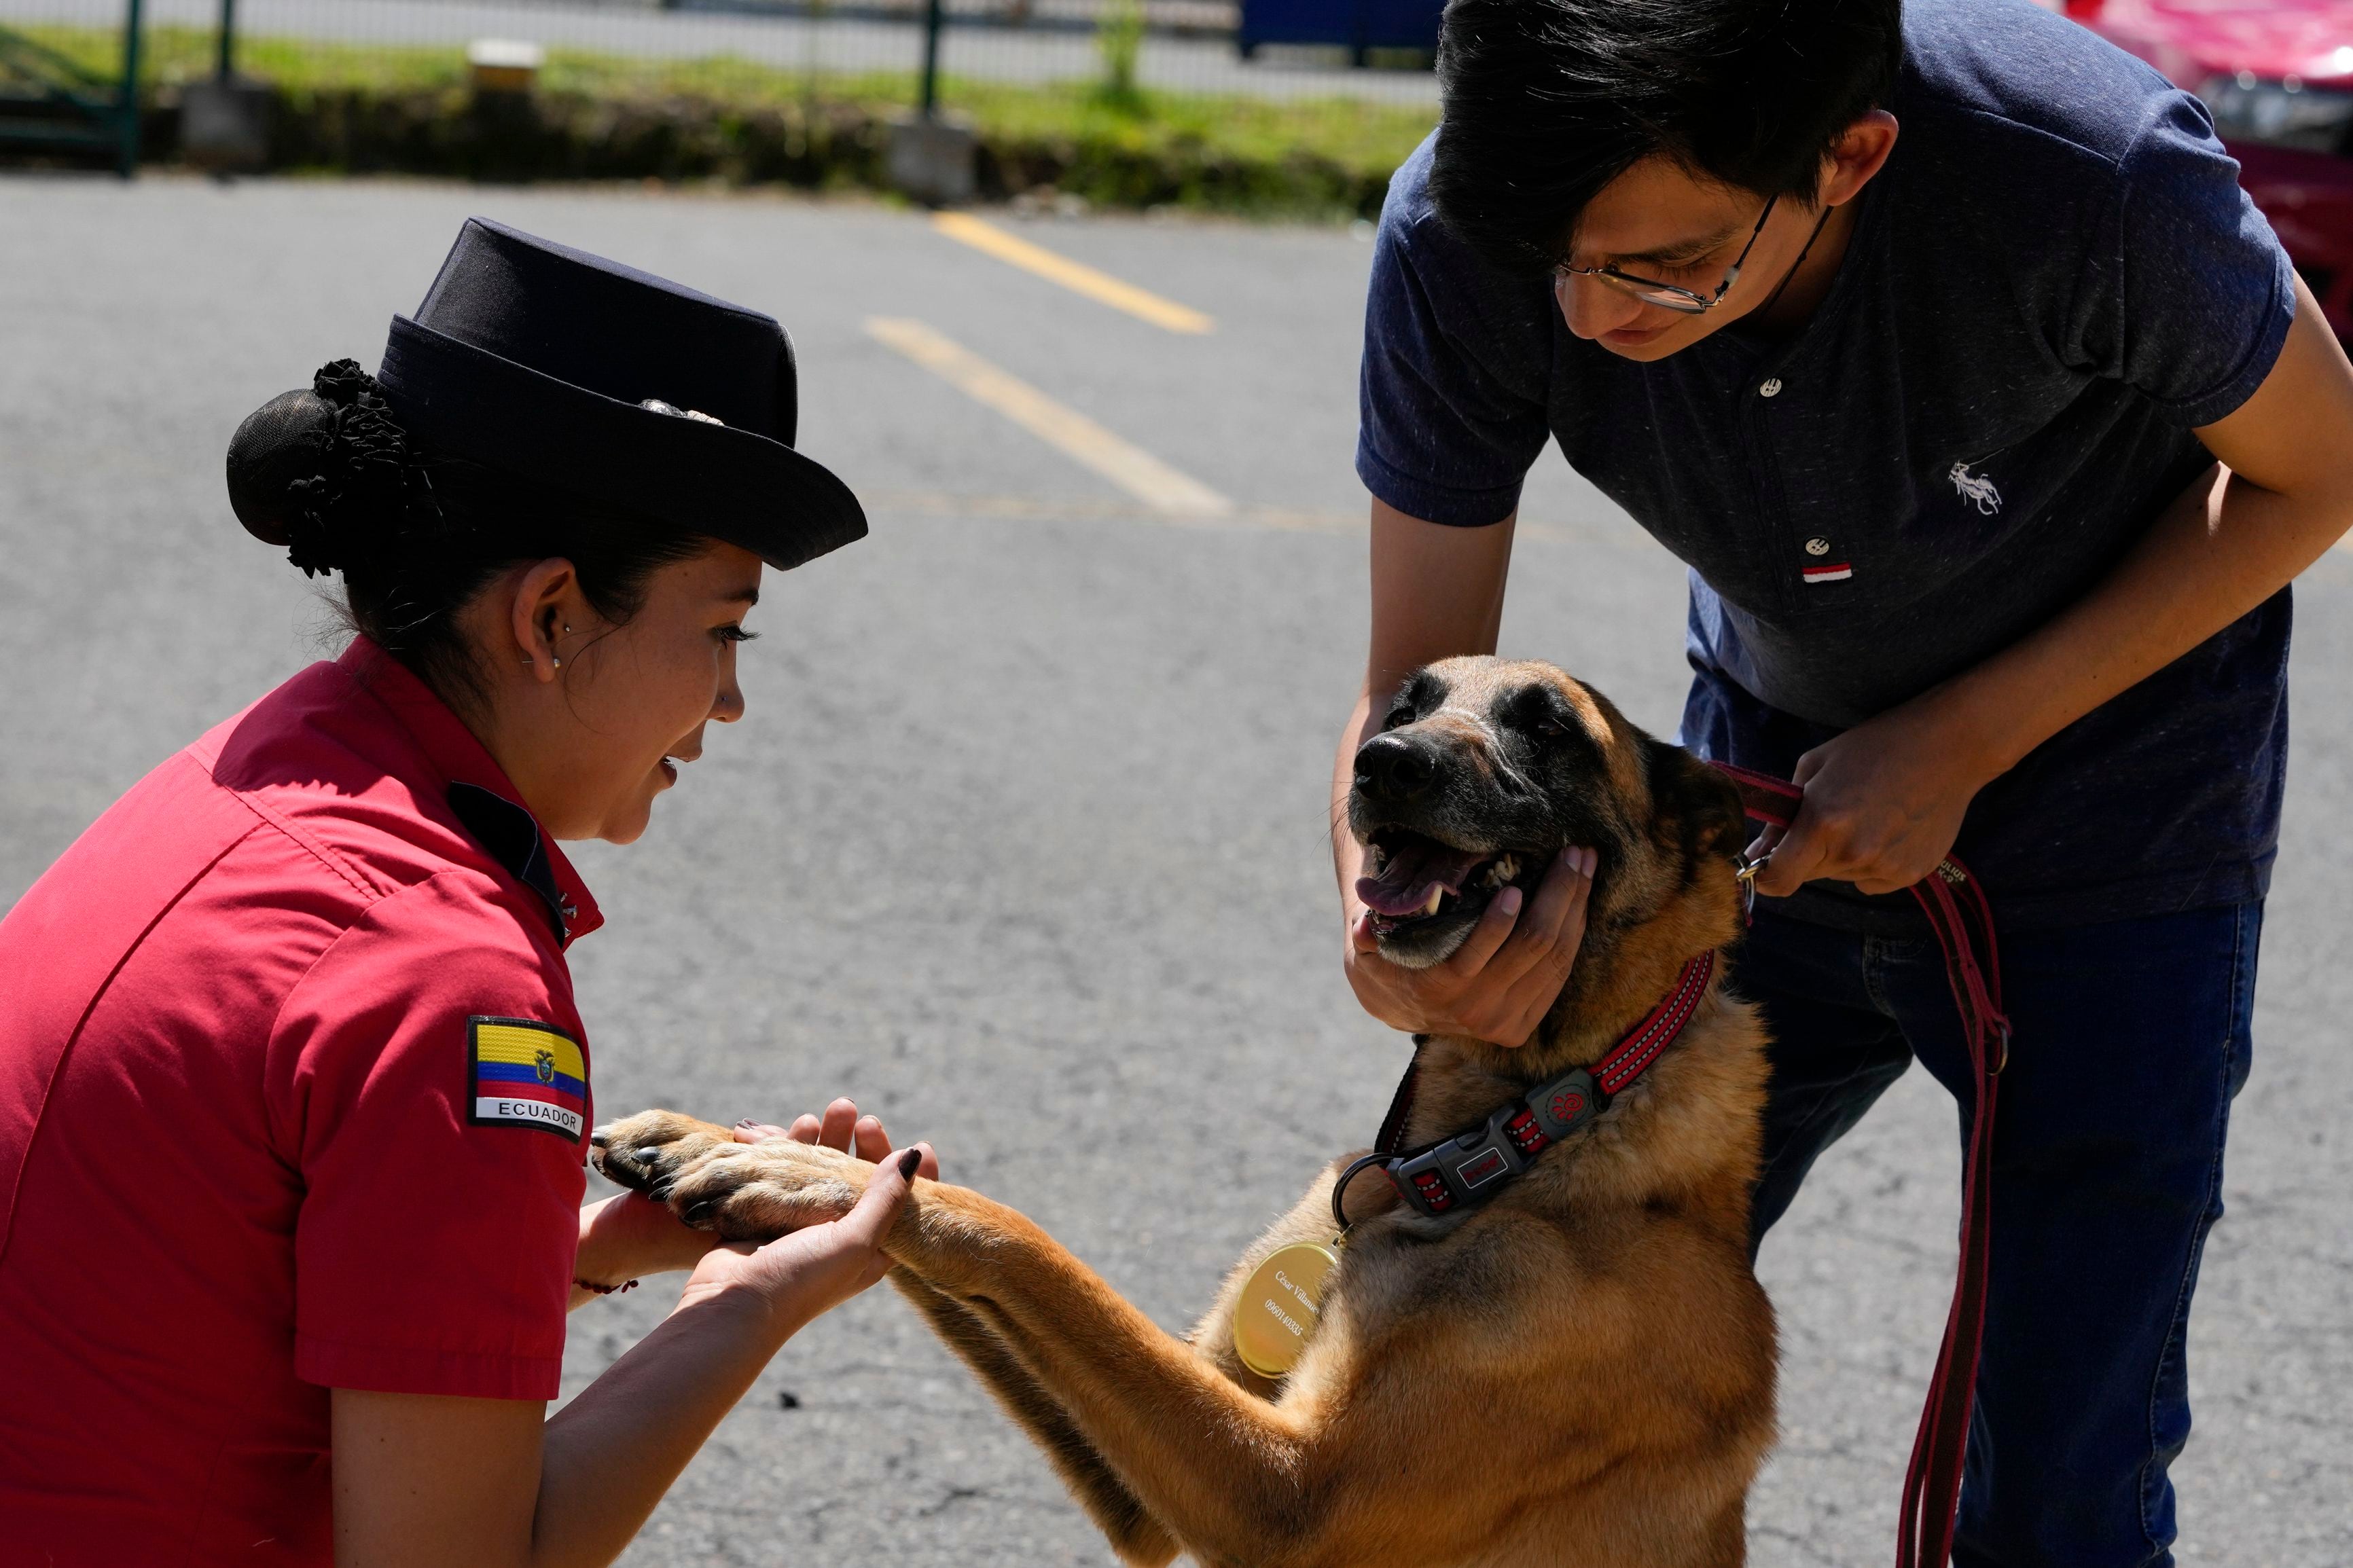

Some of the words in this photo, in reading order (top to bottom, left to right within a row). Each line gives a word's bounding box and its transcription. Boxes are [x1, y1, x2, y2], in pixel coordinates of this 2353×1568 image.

[1941, 860, 1966, 881] ULIUS
[499, 1102, 577, 1130] ECUADOR
[1275, 1271, 1294, 1291] César
